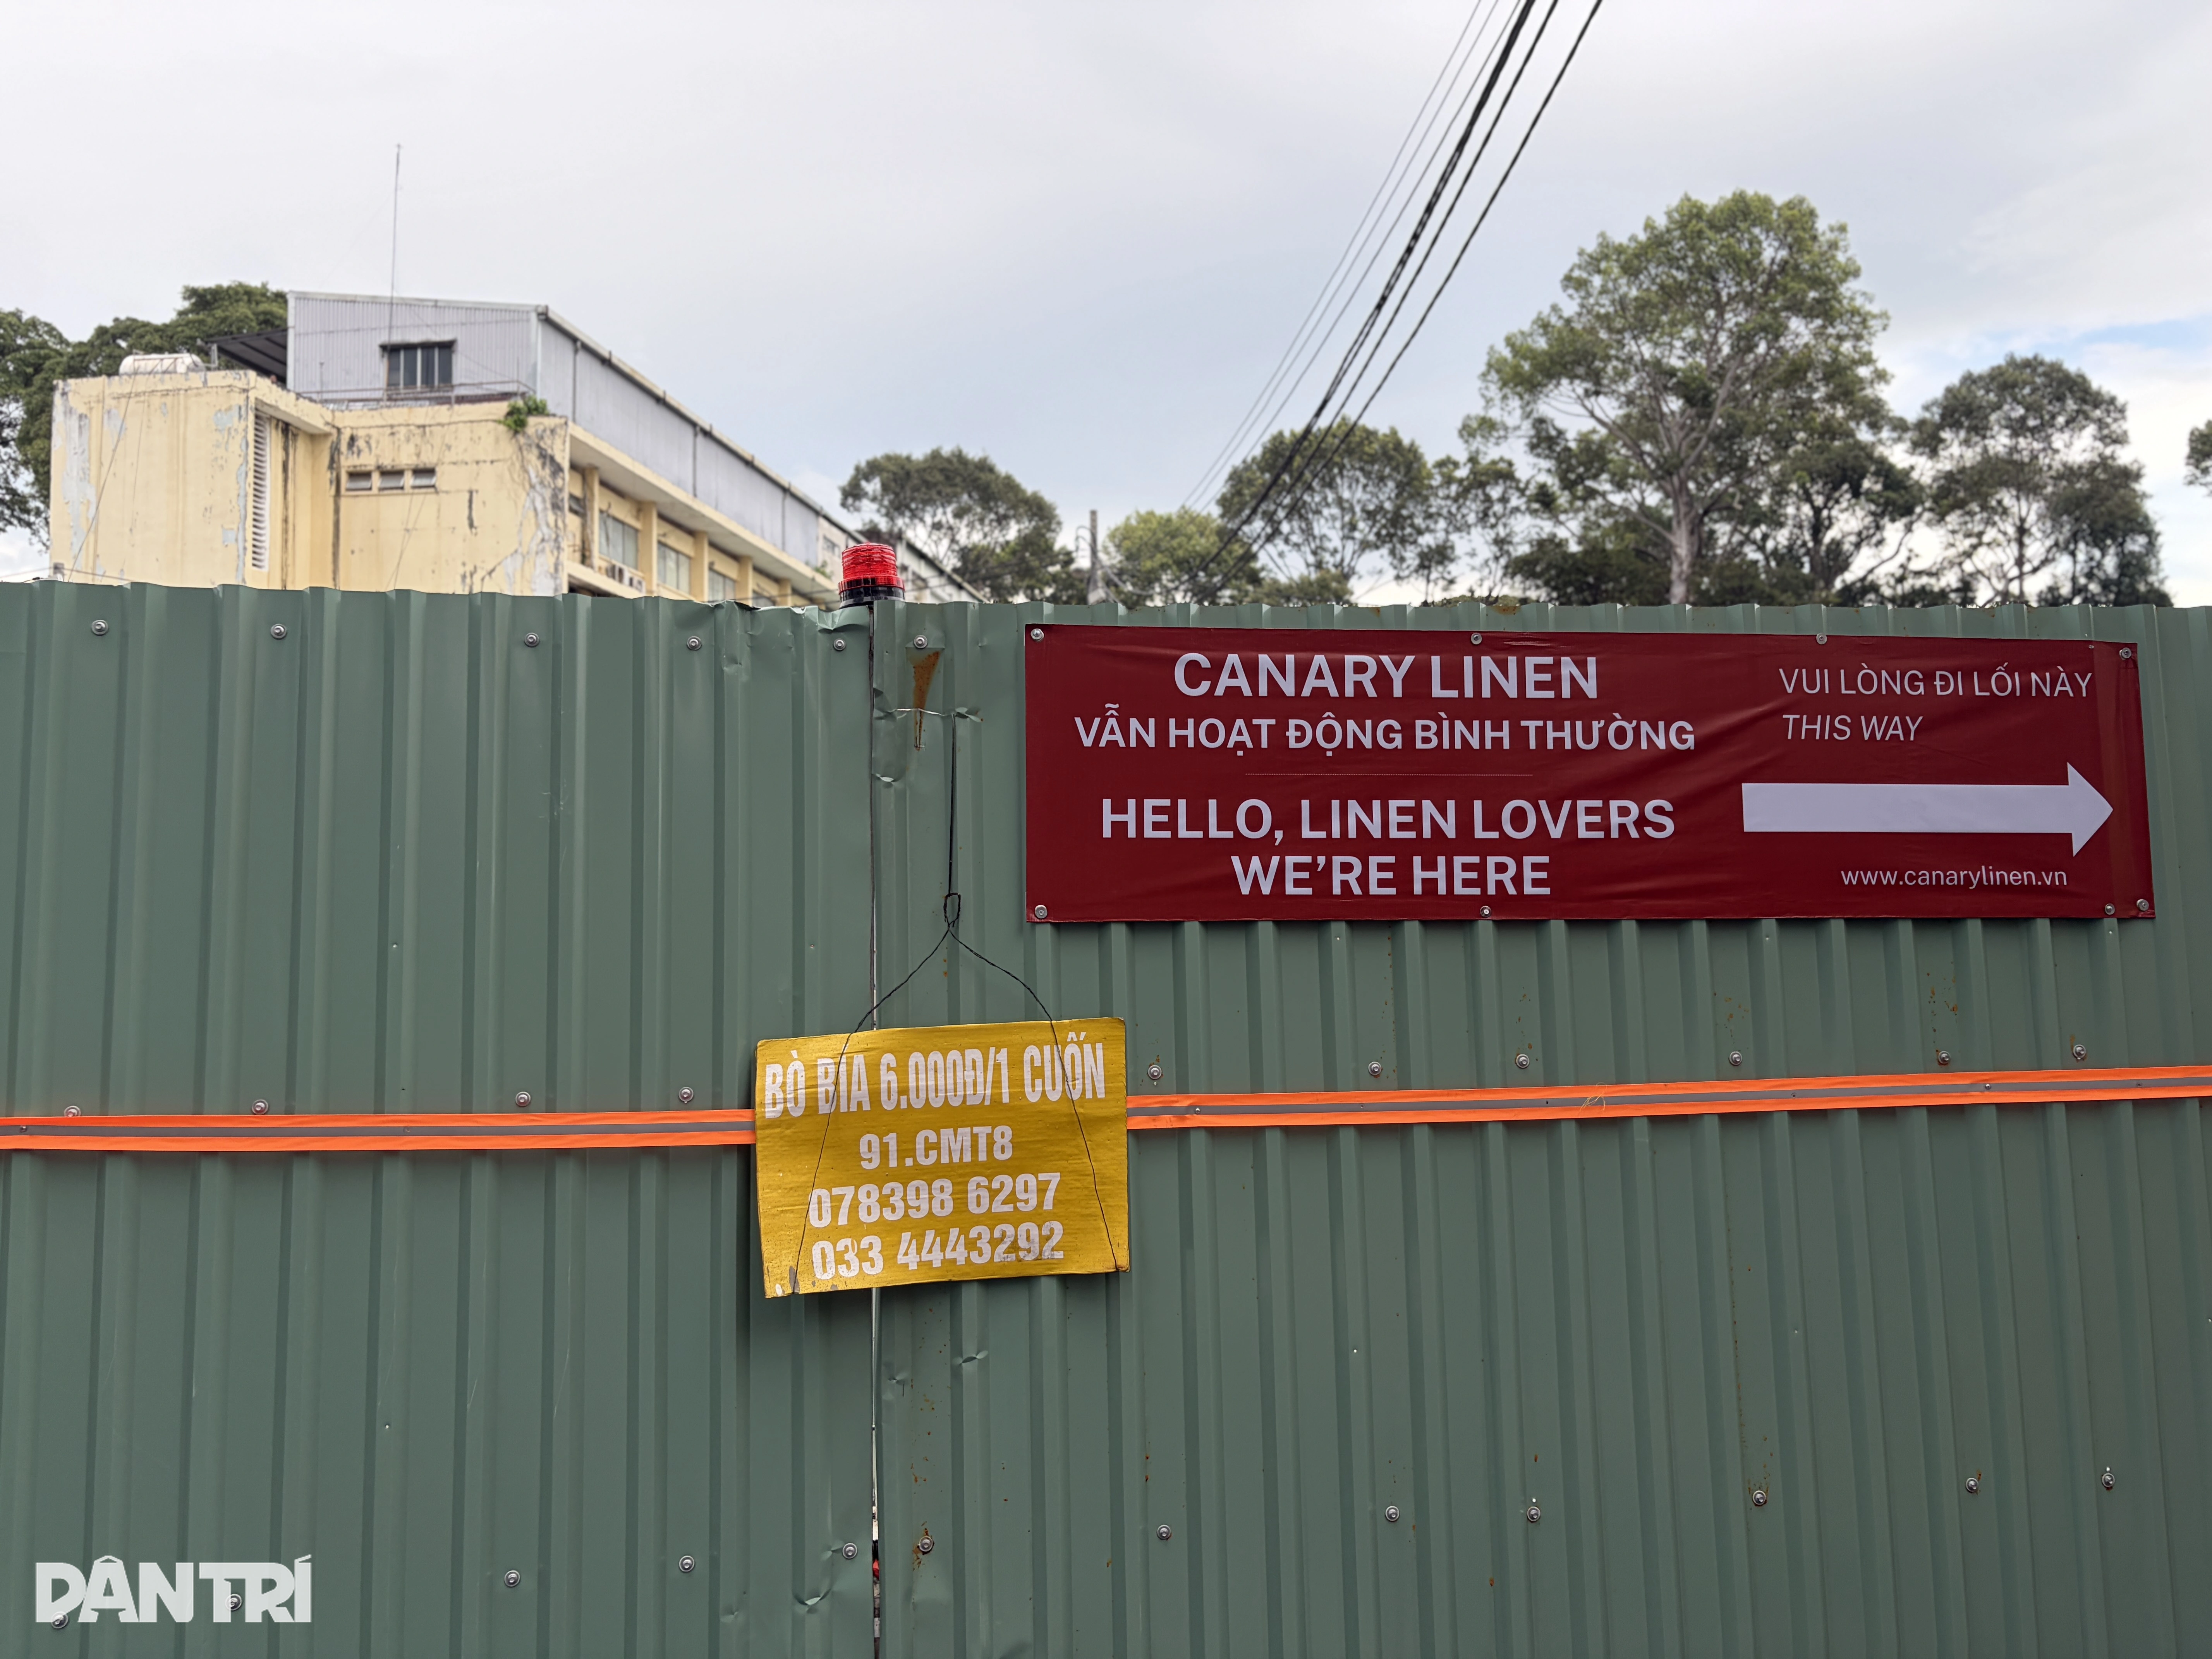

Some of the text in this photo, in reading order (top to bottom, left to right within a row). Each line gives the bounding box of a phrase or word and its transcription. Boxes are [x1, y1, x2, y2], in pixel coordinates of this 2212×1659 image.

[1175, 653, 1597, 699] CANARY LINEN
[1779, 660, 2092, 697] VUI LÒNG ĐI LỐI NÀY
[1075, 703, 1694, 757] VẪN HOẠT ĐỘNG BÌNH THƯỜNG
[1783, 714, 1923, 741] THIS WAY
[1103, 799, 1674, 846] HELLO, LINEN LOVERS
[1231, 855, 1551, 895] WE’RE HERE
[1841, 866, 2067, 889] www.canarylinen.vn
[764, 1050, 806, 1119] BÒ
[880, 1047, 1009, 1110] 6.000Đ/1
[1024, 1032, 1105, 1103] CUỐN
[860, 1125, 1013, 1170] 91.CMT8
[808, 1172, 1060, 1228] 078398 6297
[812, 1221, 1064, 1281] 033 4443292
